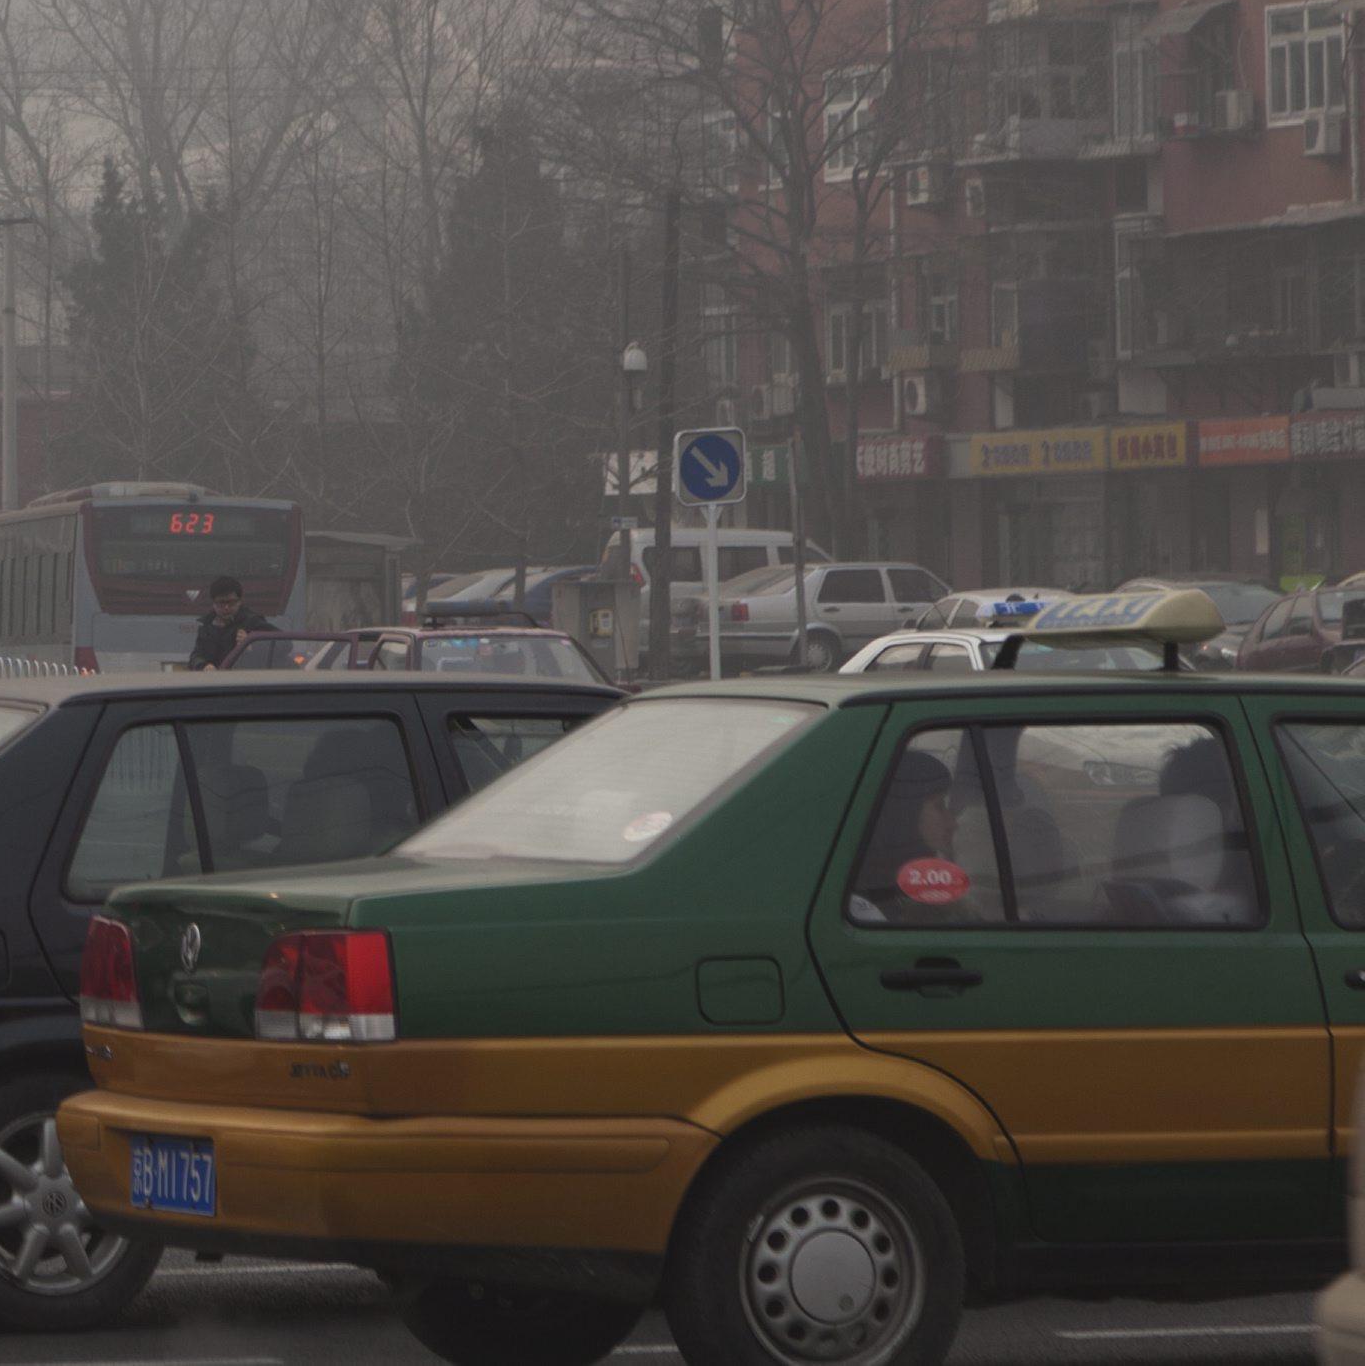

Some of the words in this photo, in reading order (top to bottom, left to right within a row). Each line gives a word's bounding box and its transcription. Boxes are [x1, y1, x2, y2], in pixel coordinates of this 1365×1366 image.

[169, 512, 215, 534] 623
[1055, 597, 1155, 619] TAXI
[909, 870, 952, 886] 2.00
